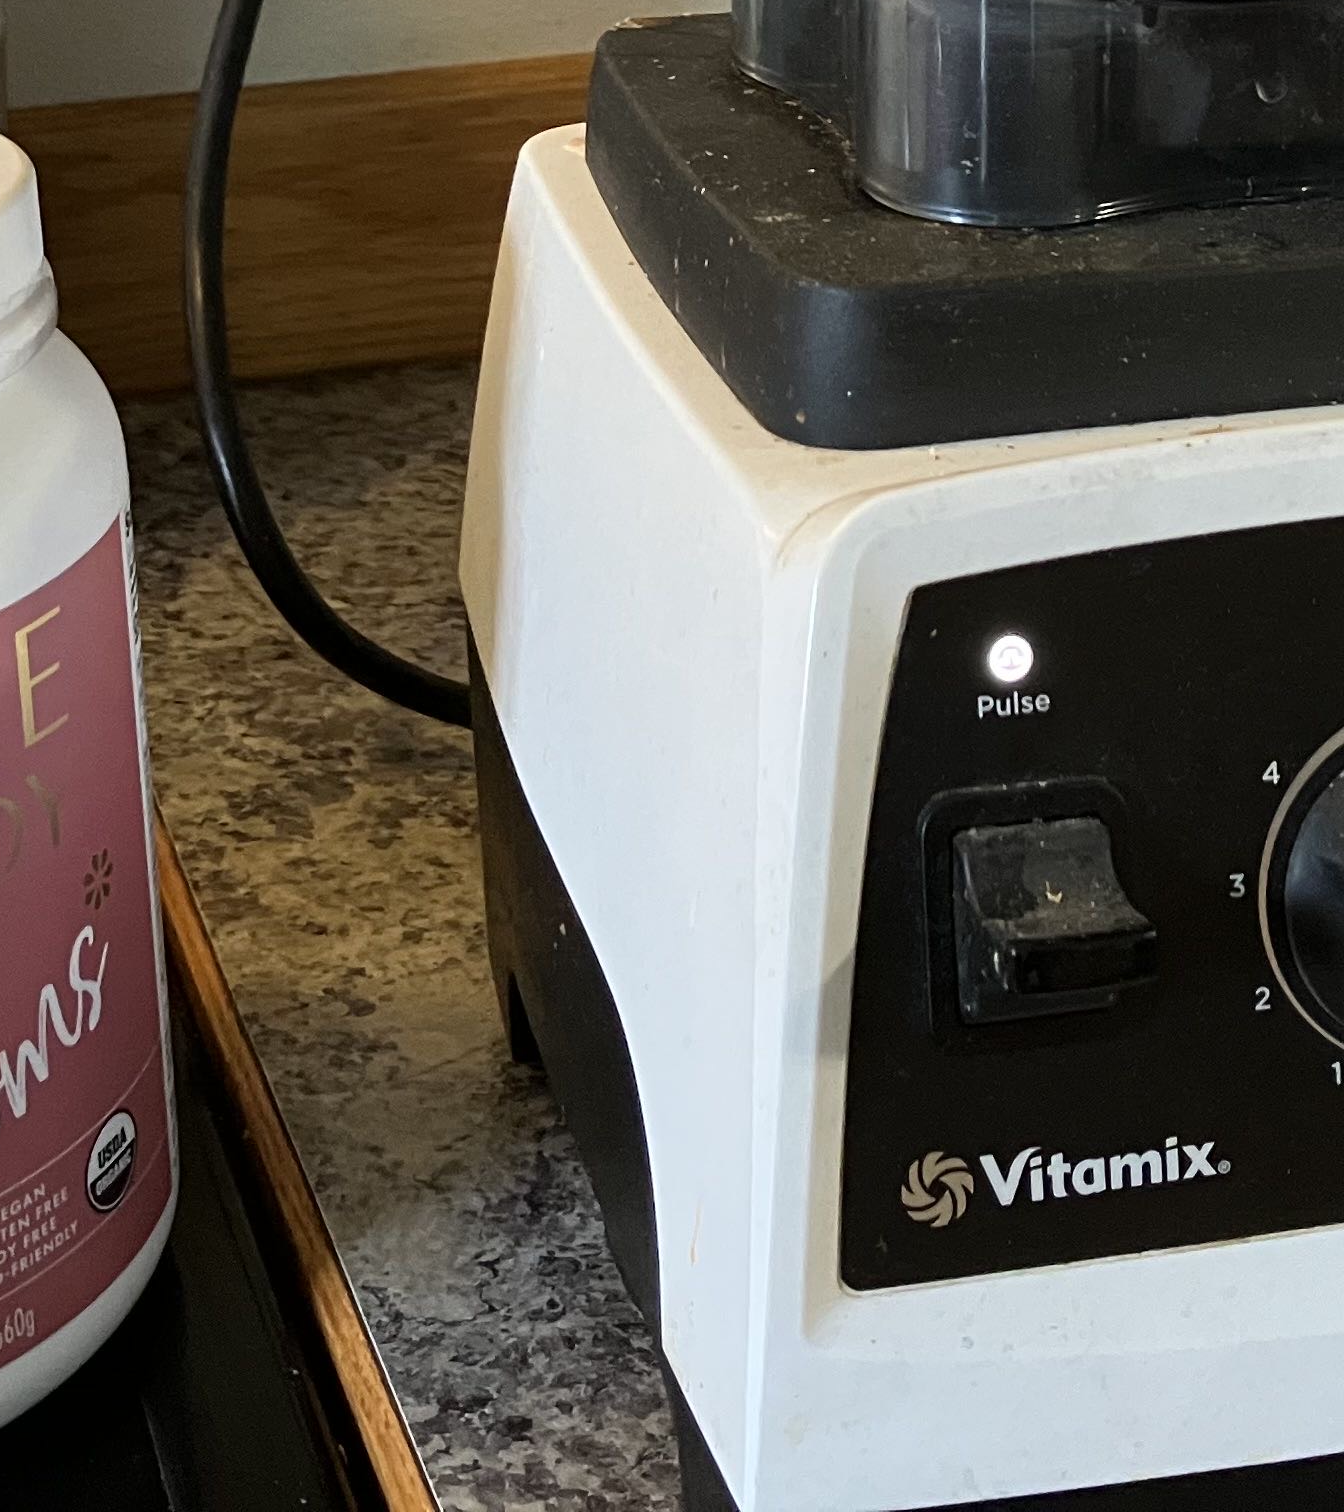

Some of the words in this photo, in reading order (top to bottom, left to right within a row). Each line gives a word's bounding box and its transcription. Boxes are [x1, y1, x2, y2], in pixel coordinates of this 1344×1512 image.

[977, 690, 1050, 719] Pulse
[1261, 761, 1280, 784] 4
[1229, 874, 1245, 898] 3
[1255, 988, 1271, 1012] 2
[1331, 1062, 1342, 1086] 1
[98, 1127, 127, 1168] USDA
[979, 1136, 1217, 1206] Vitamix
[36, 1186, 68, 1220] FREE
[23, 1216, 56, 1249] FREE
